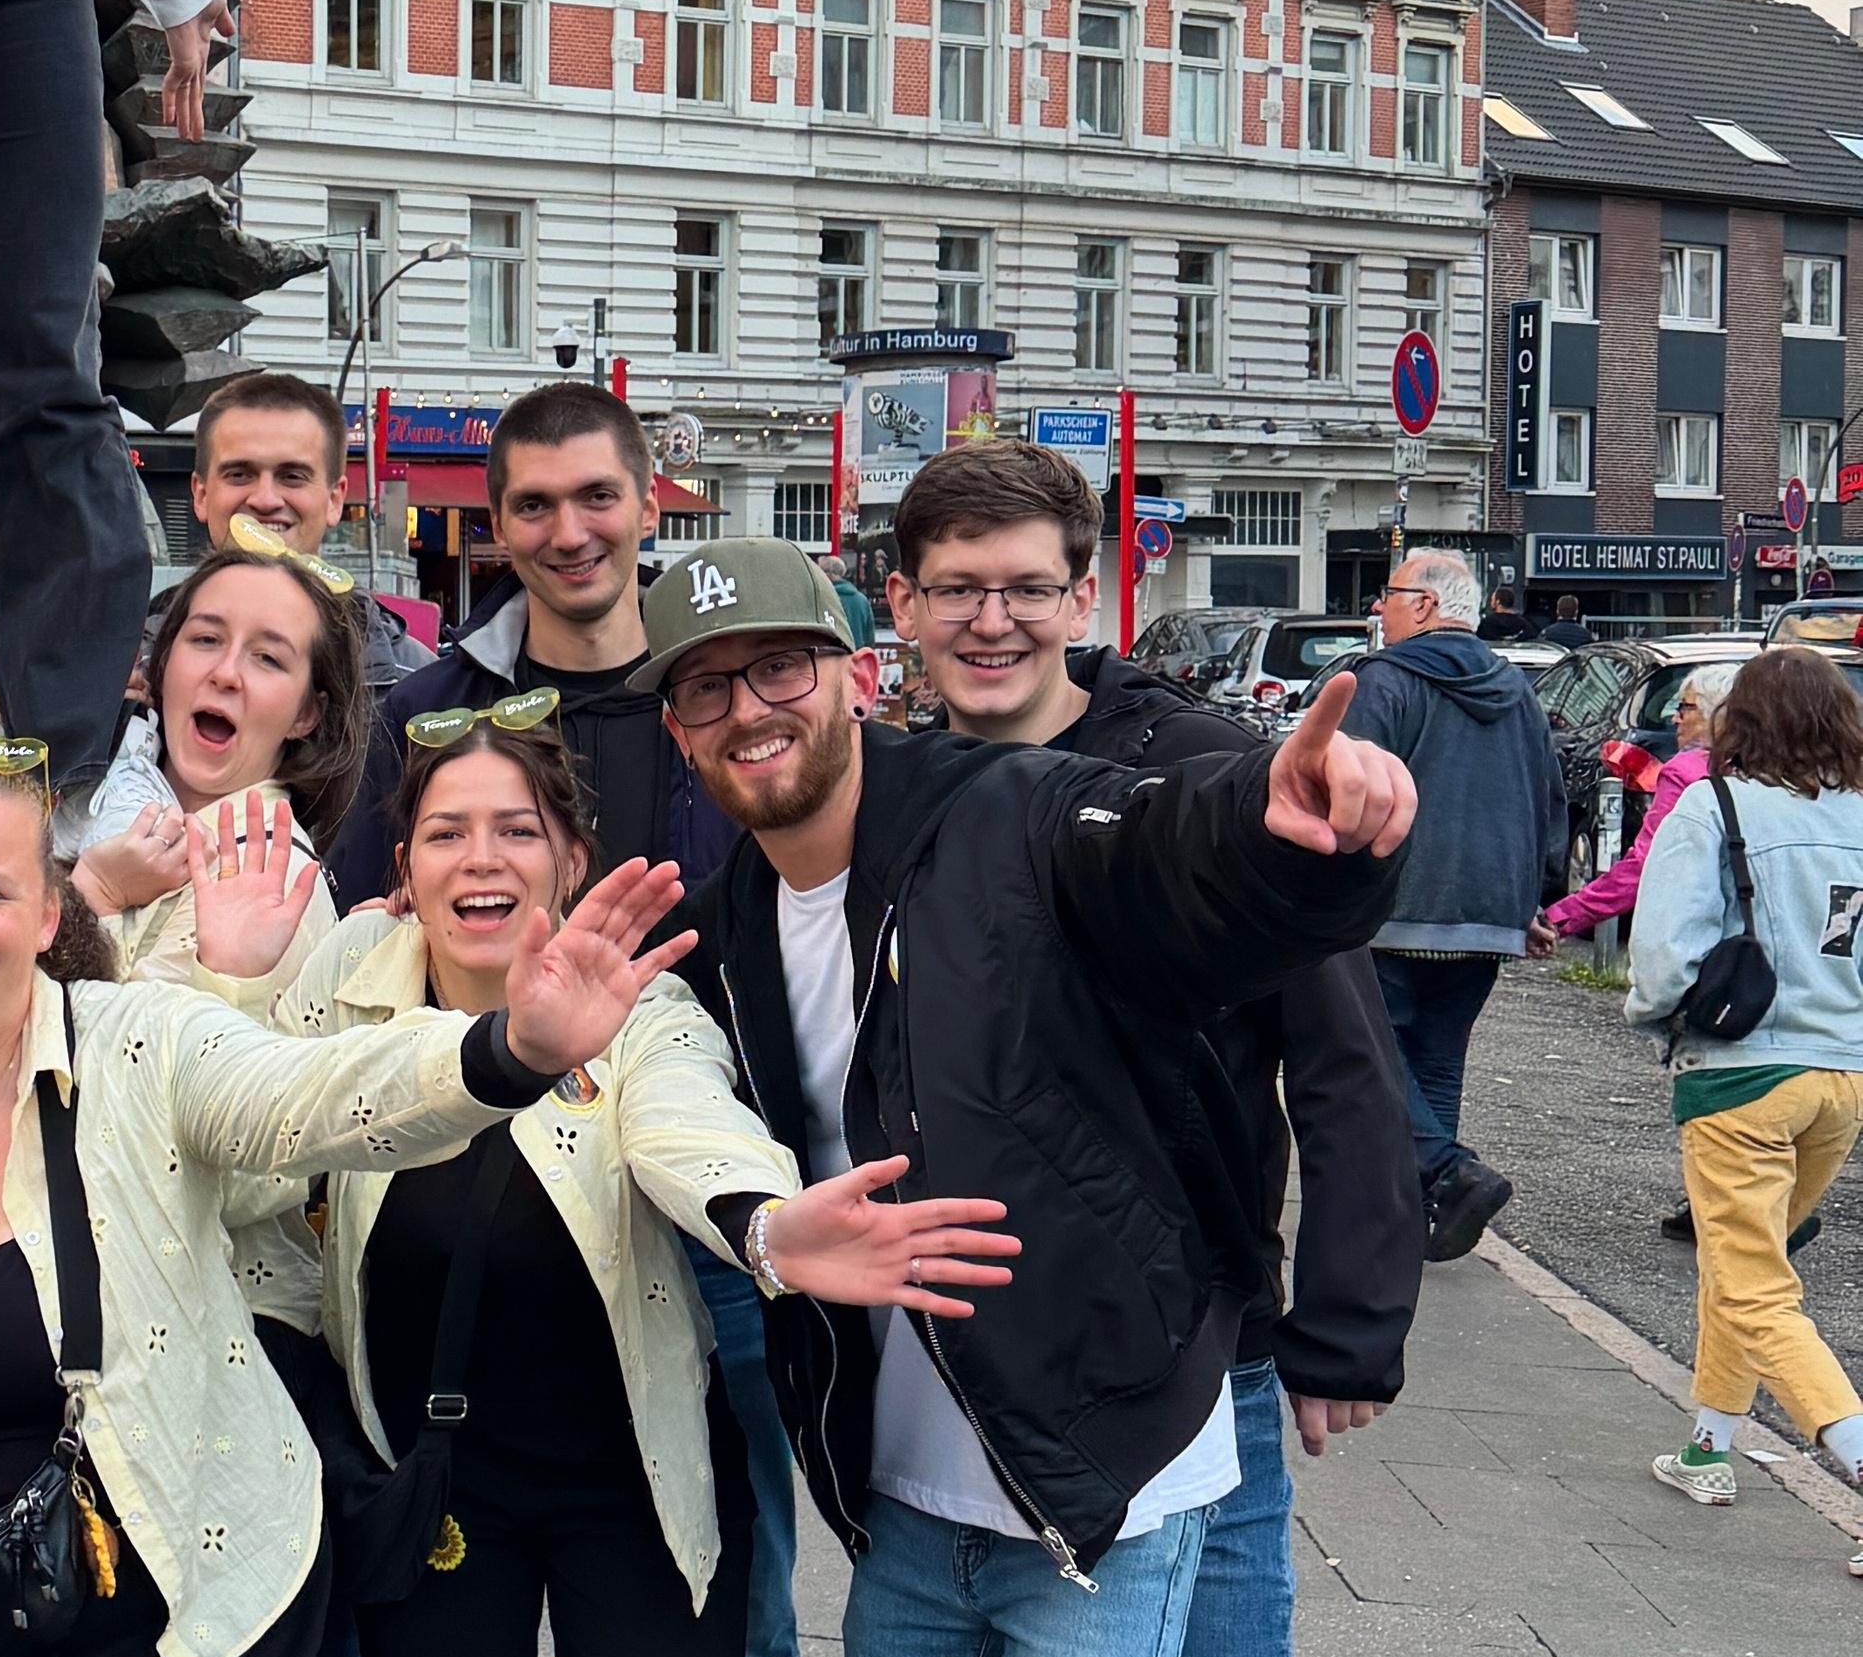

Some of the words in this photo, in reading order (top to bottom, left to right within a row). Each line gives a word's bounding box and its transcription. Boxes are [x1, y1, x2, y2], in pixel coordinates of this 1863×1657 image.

[865, 333, 881, 350] in
[887, 331, 977, 352] Hamburg
[1517, 314, 1534, 478] HOTEL
[1051, 429, 1093, 443] AUTOMAT
[860, 471, 914, 483] SKULPTU
[1541, 545, 1591, 568] HOTEL
[1596, 546, 1651, 569] HEIMAT
[1657, 546, 1720, 570] ST.PAULI
[687, 559, 737, 614] LA
